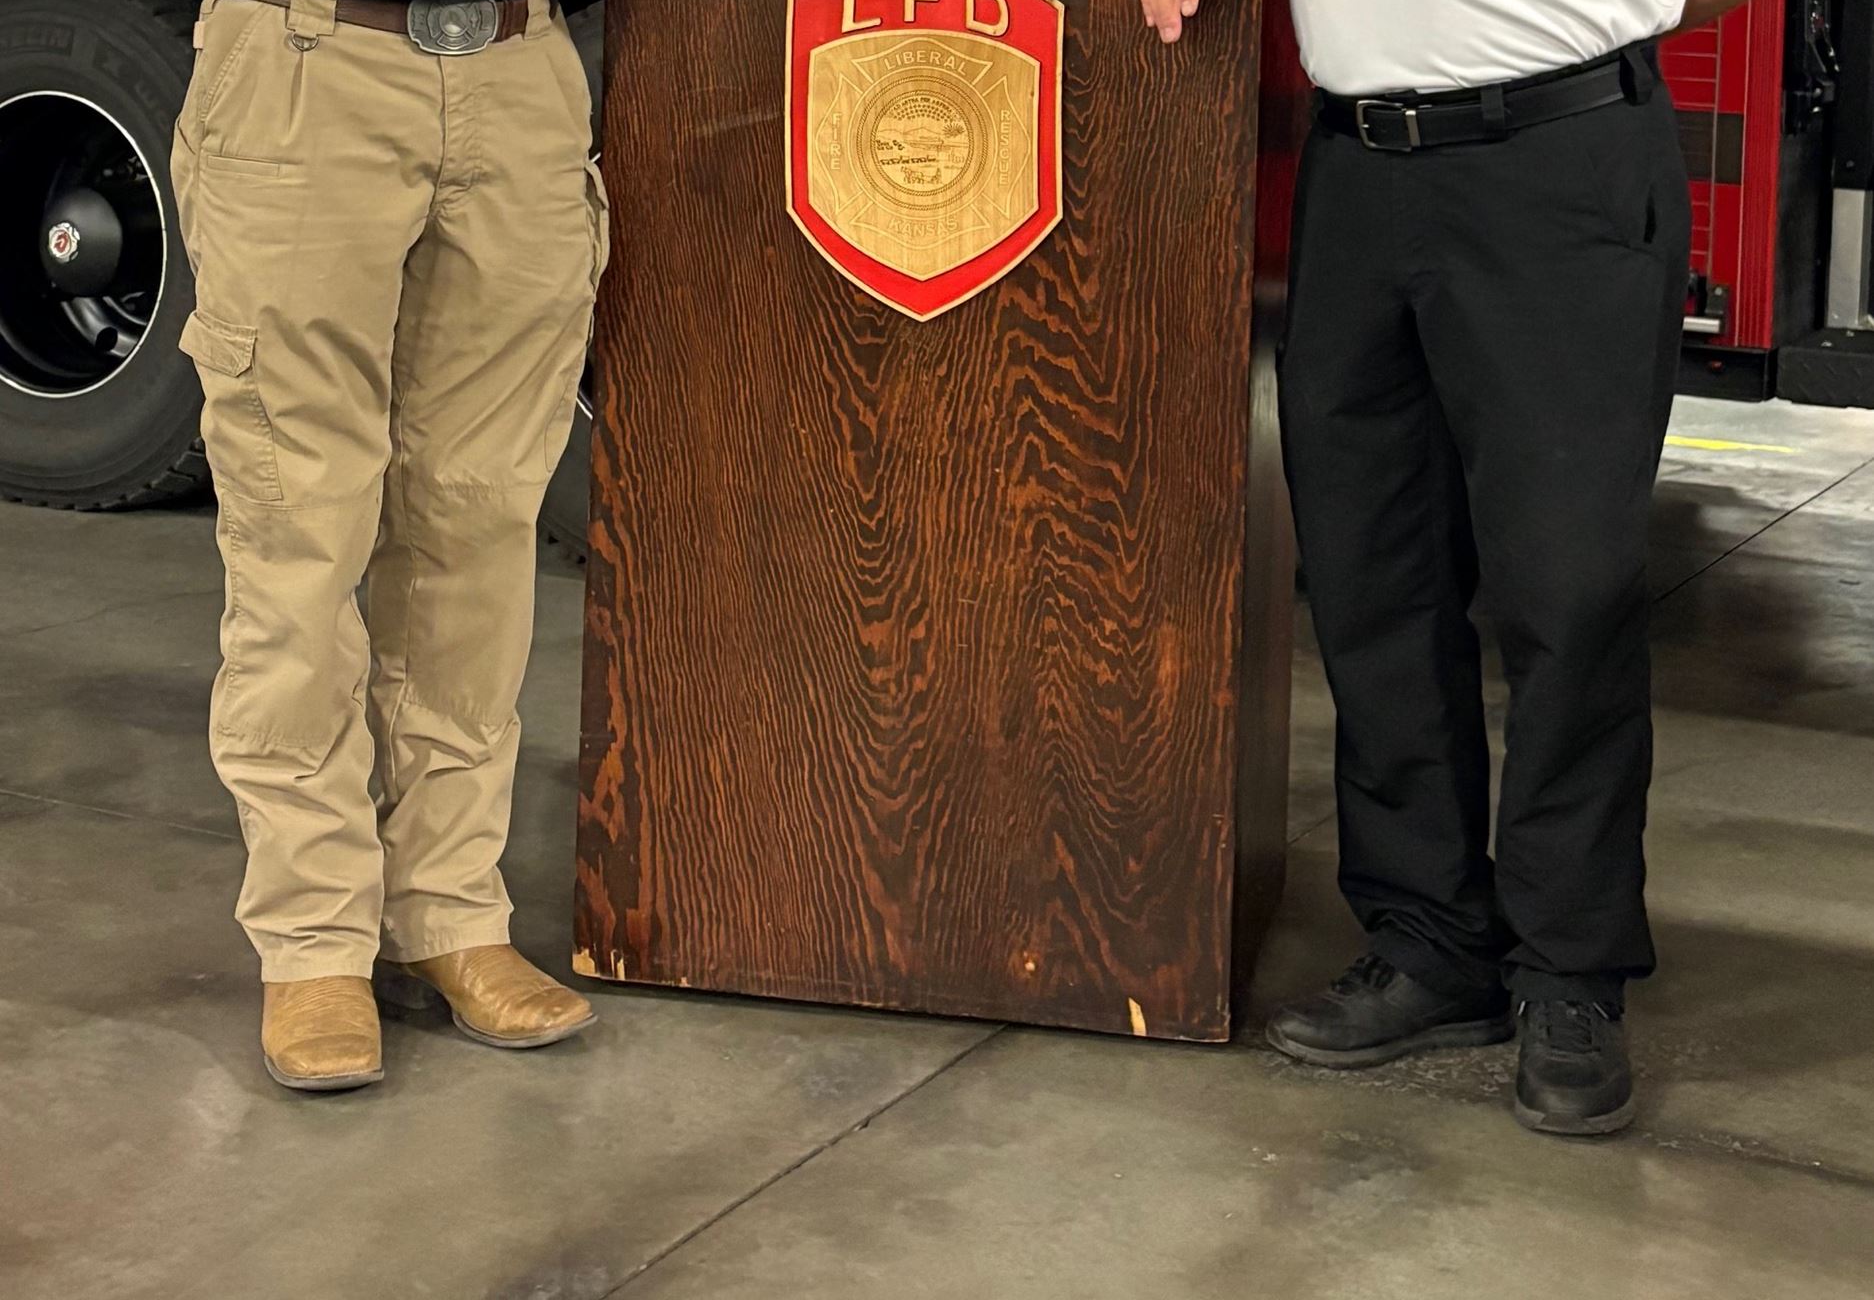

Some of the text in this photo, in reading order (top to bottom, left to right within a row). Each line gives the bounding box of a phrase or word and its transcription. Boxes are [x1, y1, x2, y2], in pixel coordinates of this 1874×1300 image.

[883, 50, 967, 76] LIBERAL
[830, 112, 841, 170] FIRE
[999, 109, 1010, 185] RESCUE
[888, 214, 958, 238] KANSAS
